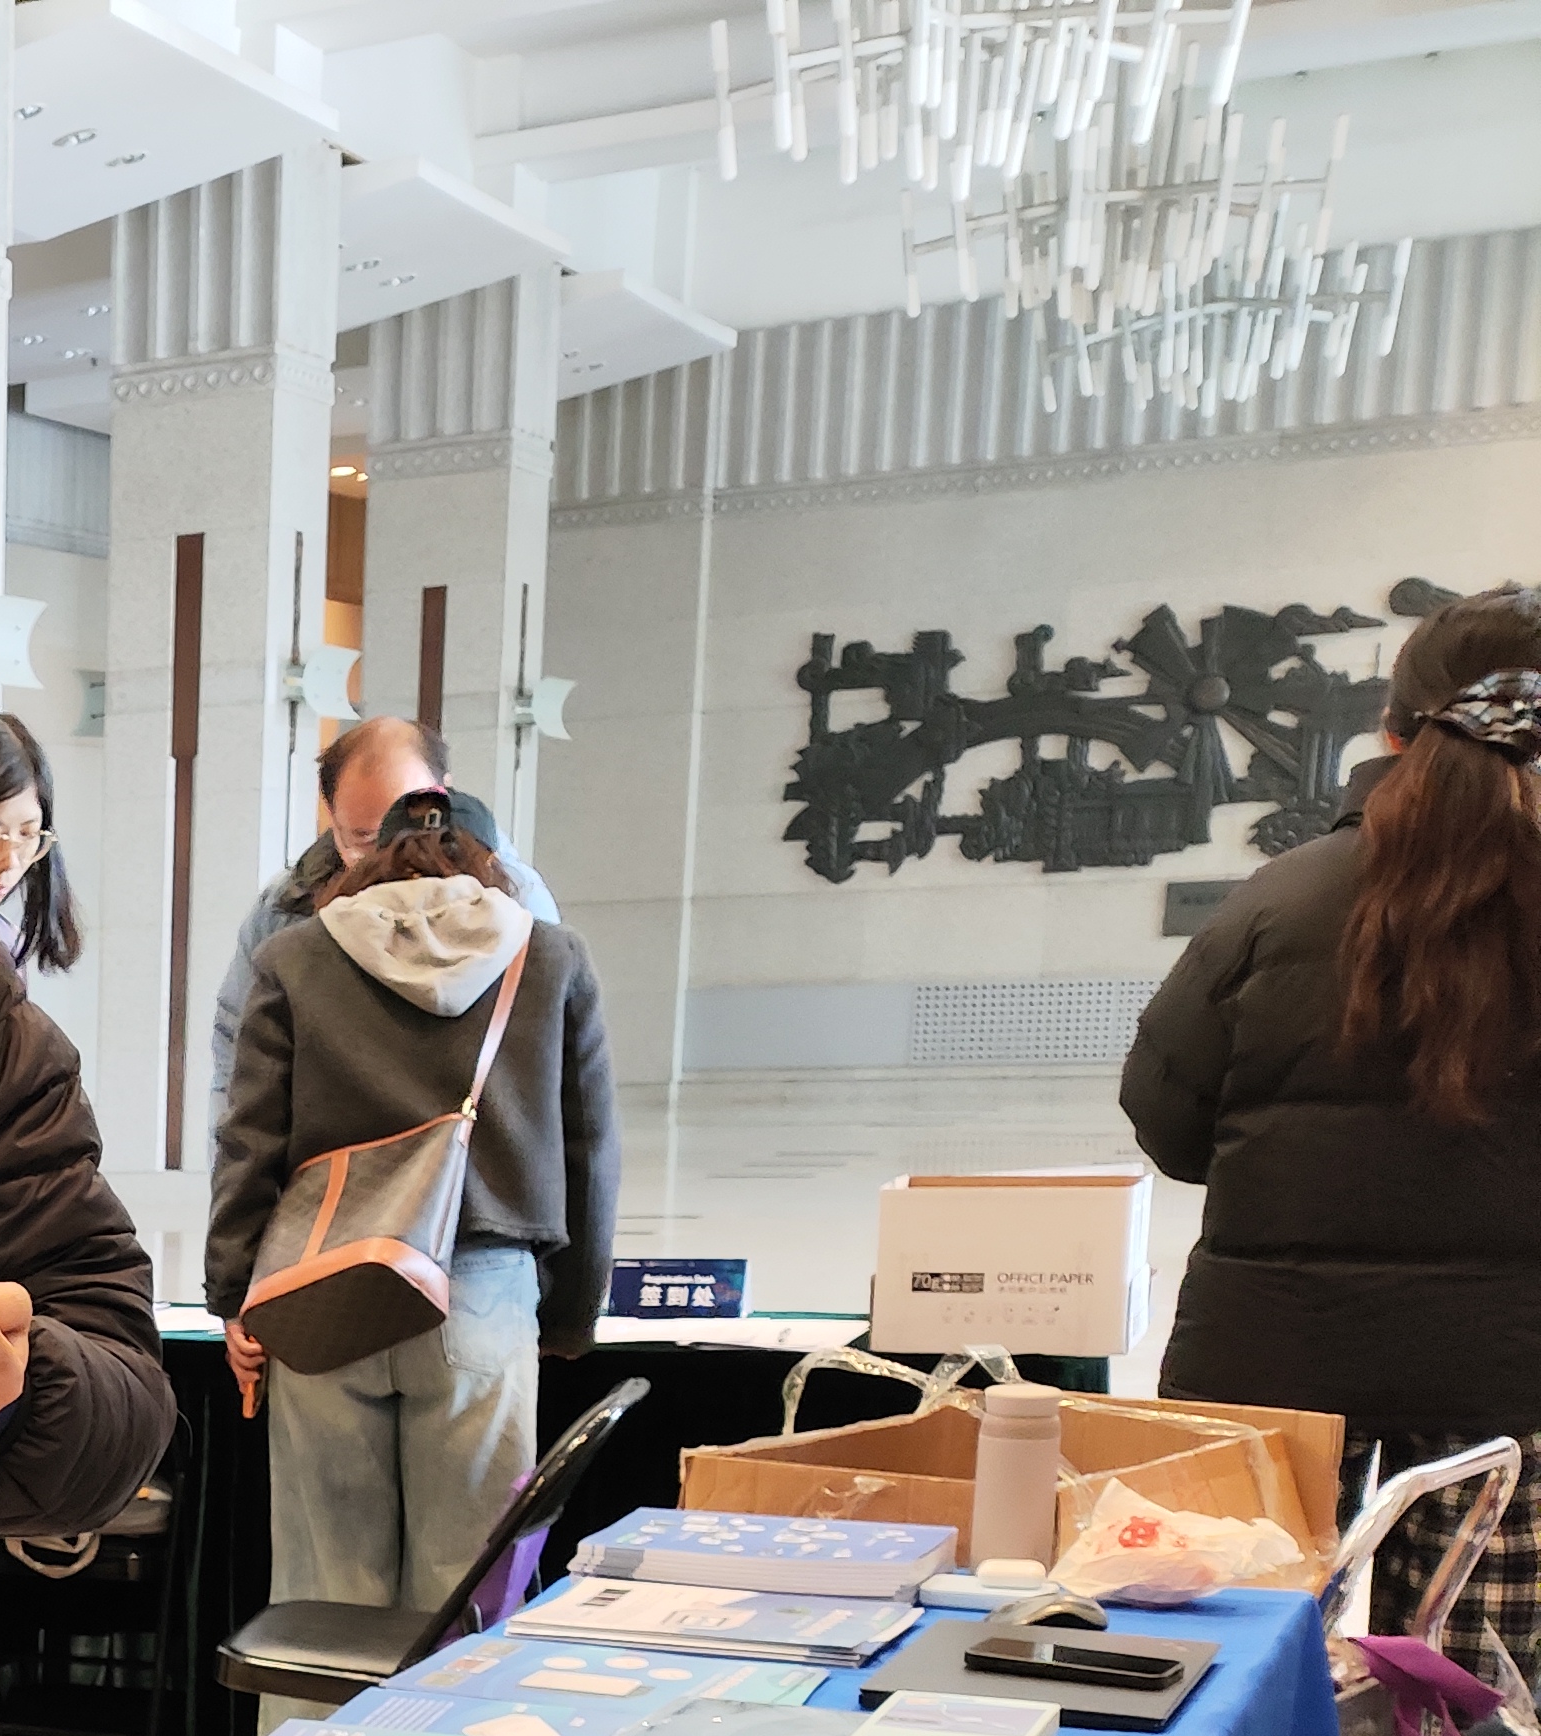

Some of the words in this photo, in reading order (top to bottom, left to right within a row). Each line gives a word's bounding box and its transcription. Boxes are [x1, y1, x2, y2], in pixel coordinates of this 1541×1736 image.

[996, 1272, 1045, 1285] OFFICE
[1049, 1272, 1095, 1286] PAPER
[638, 1285, 716, 1307] 签到处
